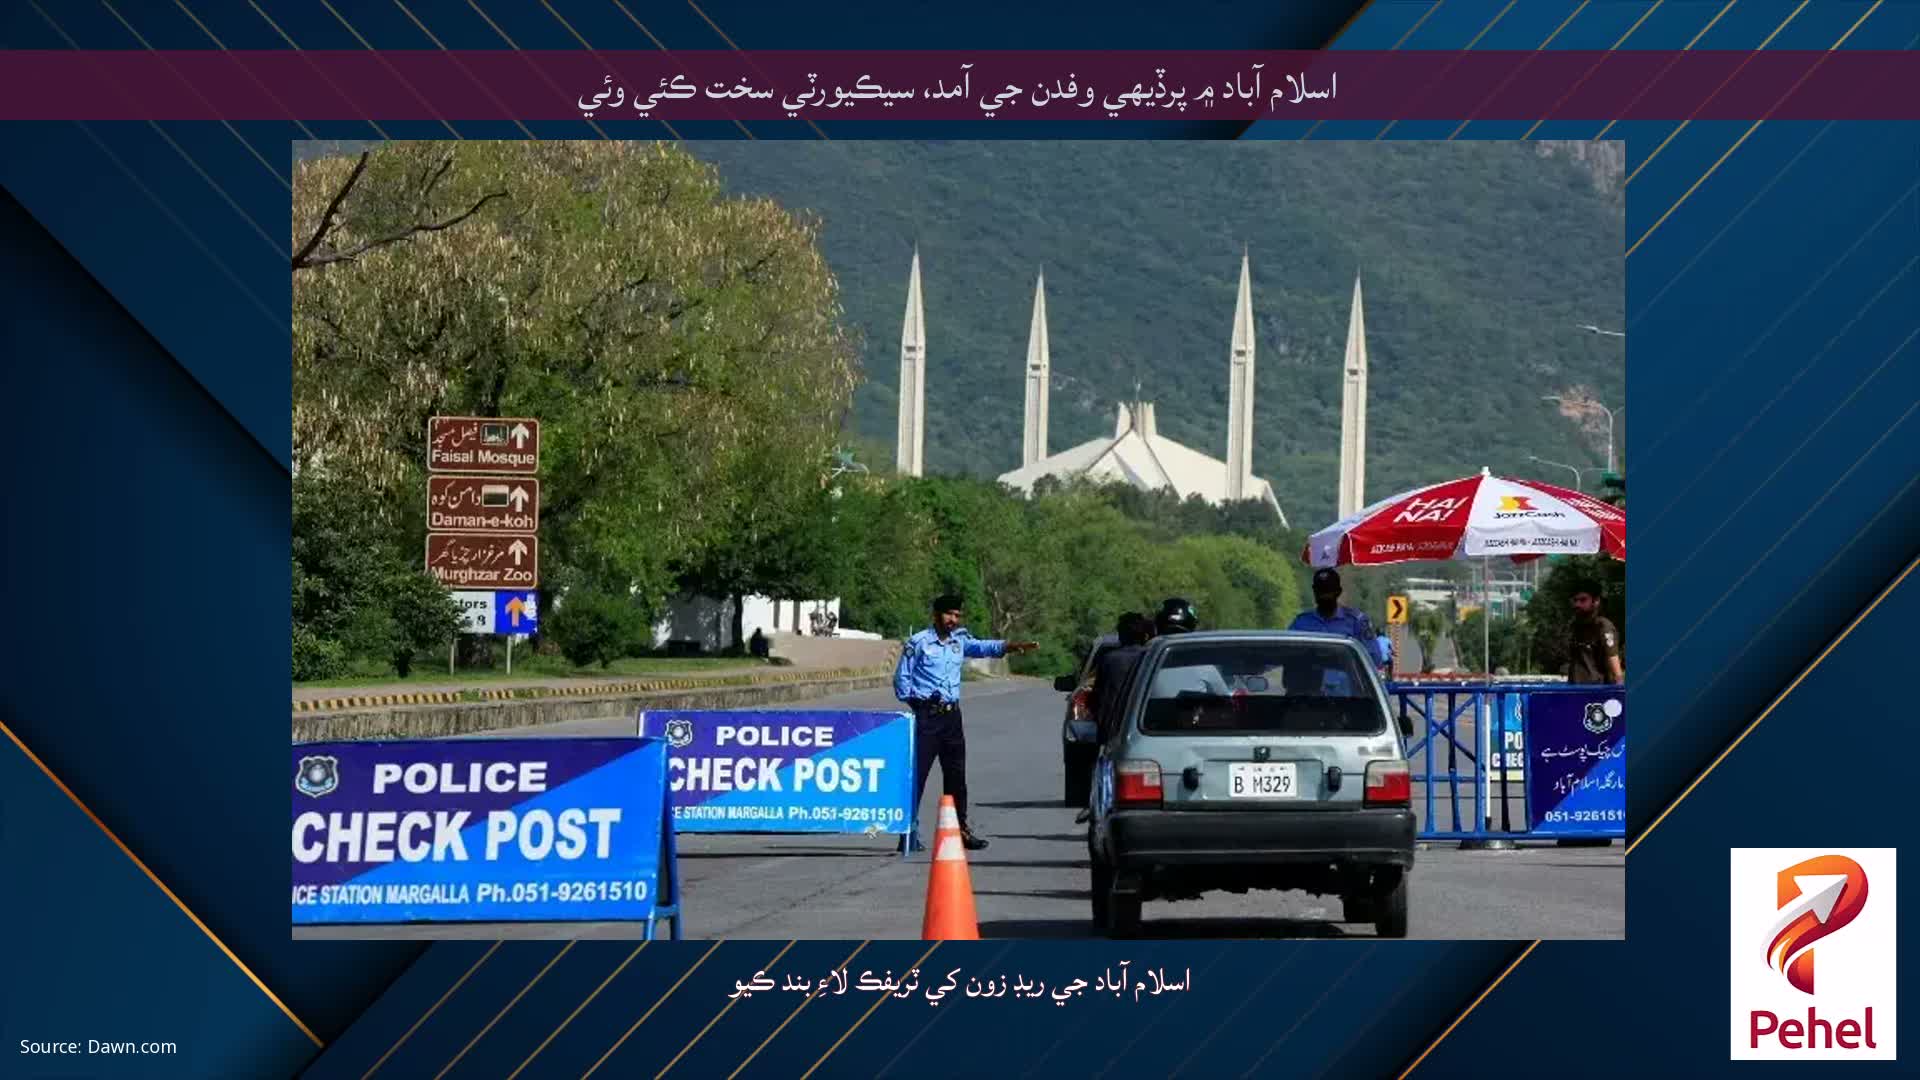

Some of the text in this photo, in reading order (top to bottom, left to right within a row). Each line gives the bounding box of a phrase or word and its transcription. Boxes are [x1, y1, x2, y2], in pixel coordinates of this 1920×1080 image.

[432, 422, 478, 448] فیصل مسجد
[432, 449, 535, 467] Faisal Mosque
[448, 486, 480, 509] دامن
[432, 511, 534, 528] Daman-e-koh
[431, 567, 532, 584] Murghzar Zoo
[716, 726, 834, 747] POLICE
[1541, 747, 1557, 763] ہے
[373, 761, 549, 795] POLICE
[669, 757, 886, 793] CHECK POST
[1252, 775, 1292, 794] M329
[684, 806, 726, 819] STATION
[728, 806, 784, 819] MARGALLA
[788, 806, 905, 822] Ph.051-9261510
[1544, 810, 1626, 823] 051-926151
[292, 807, 622, 864] CHECK POST
[320, 884, 384, 905] STATION
[386, 883, 470, 904] MARGALLA
[476, 880, 648, 904] Ph.051-9261510
